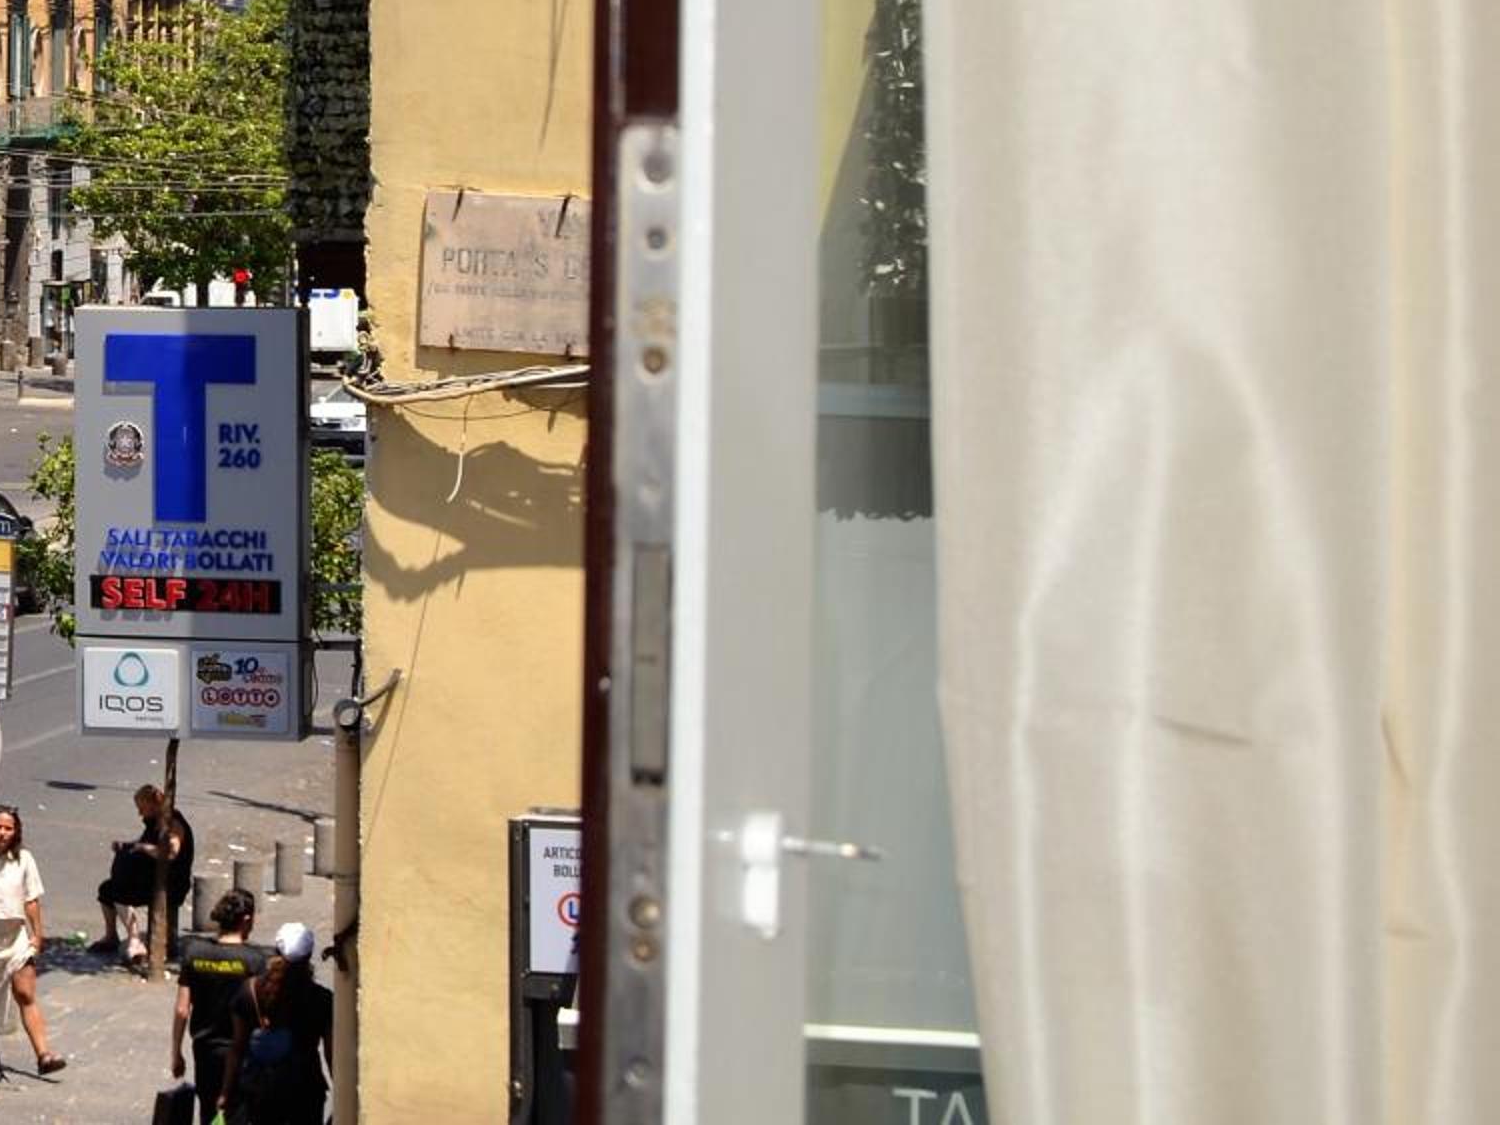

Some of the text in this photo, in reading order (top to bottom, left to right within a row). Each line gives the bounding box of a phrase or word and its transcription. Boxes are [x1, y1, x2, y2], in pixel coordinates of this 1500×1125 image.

[106, 334, 256, 523] T
[219, 424, 260, 443] RIV.
[218, 448, 261, 469] 260
[108, 528, 267, 549] SALI TABACCHI
[101, 550, 273, 572] VALORI BOLLATI
[101, 577, 186, 609] SELF
[99, 694, 164, 713] IQOS
[201, 687, 281, 708] LOTTO
